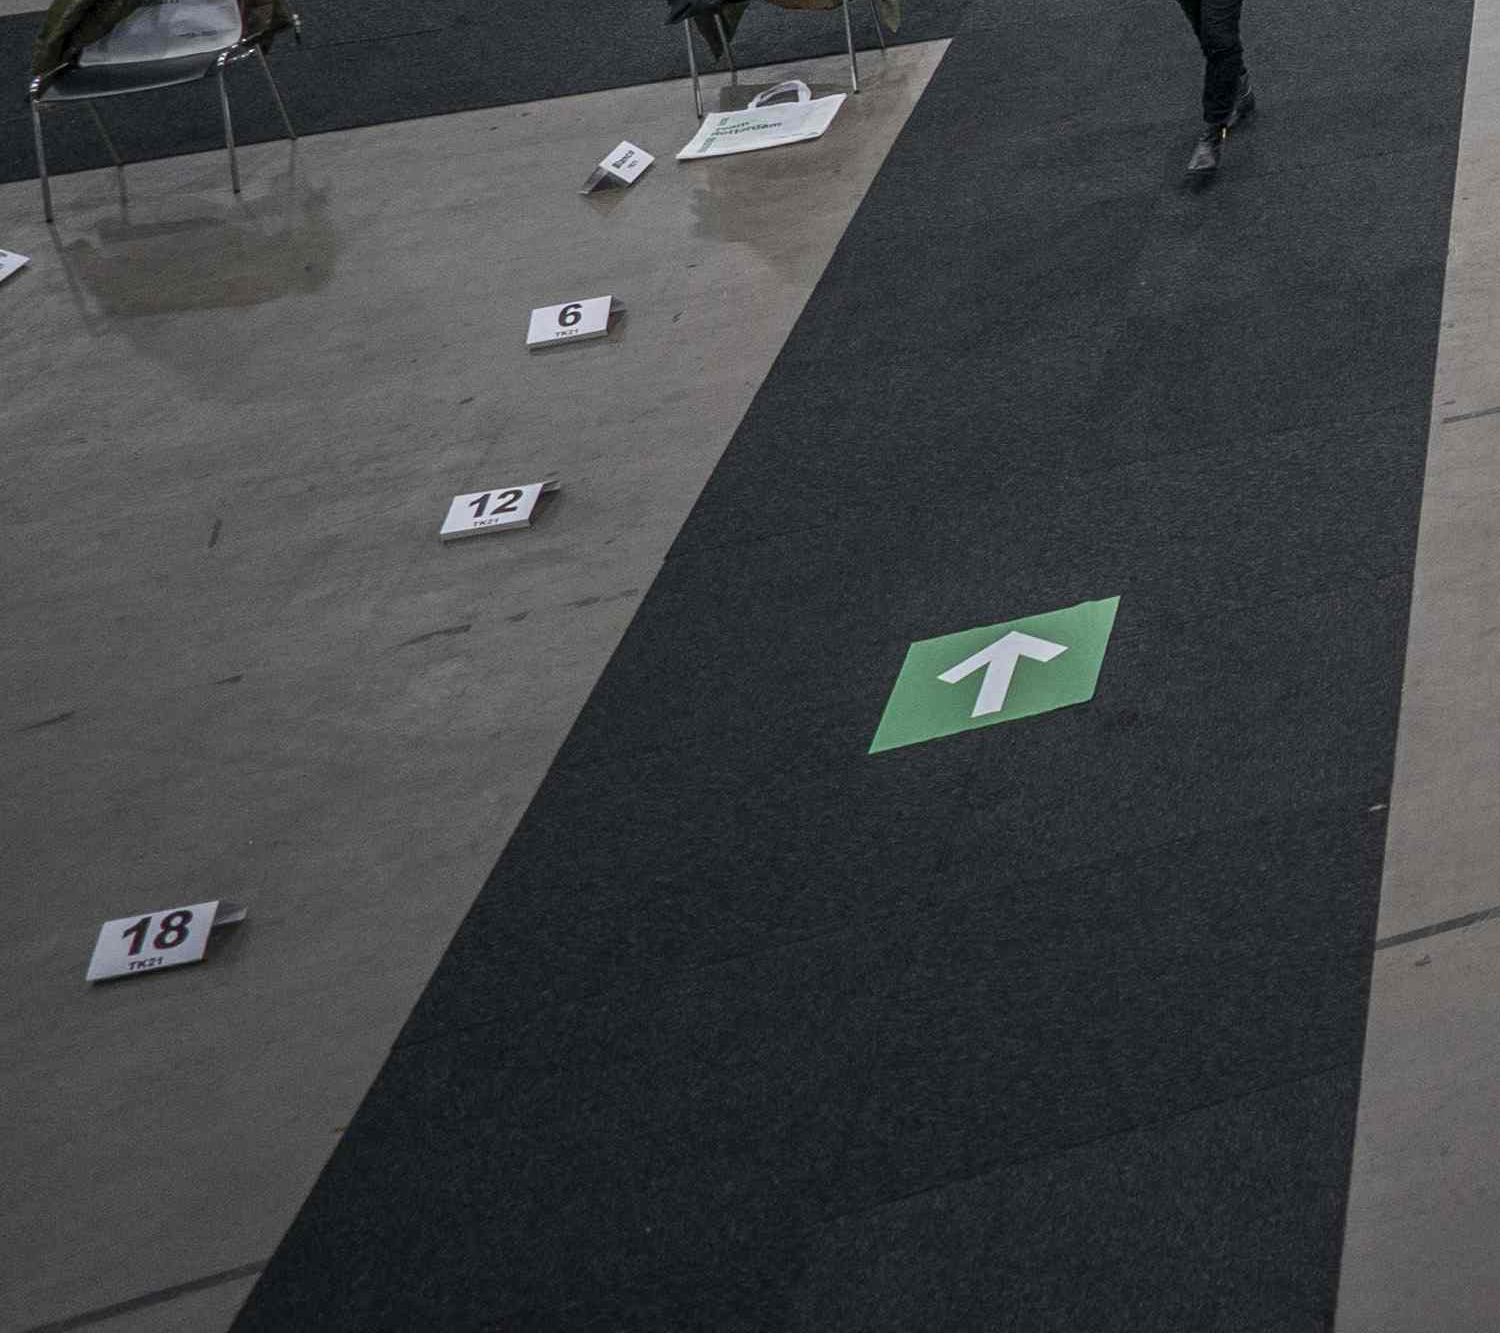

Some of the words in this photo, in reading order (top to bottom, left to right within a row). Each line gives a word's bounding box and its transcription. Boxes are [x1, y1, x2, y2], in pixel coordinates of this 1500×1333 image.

[559, 304, 582, 327] 6
[470, 490, 523, 518] 12
[123, 910, 192, 955] 18
[130, 958, 163, 971] TK21
